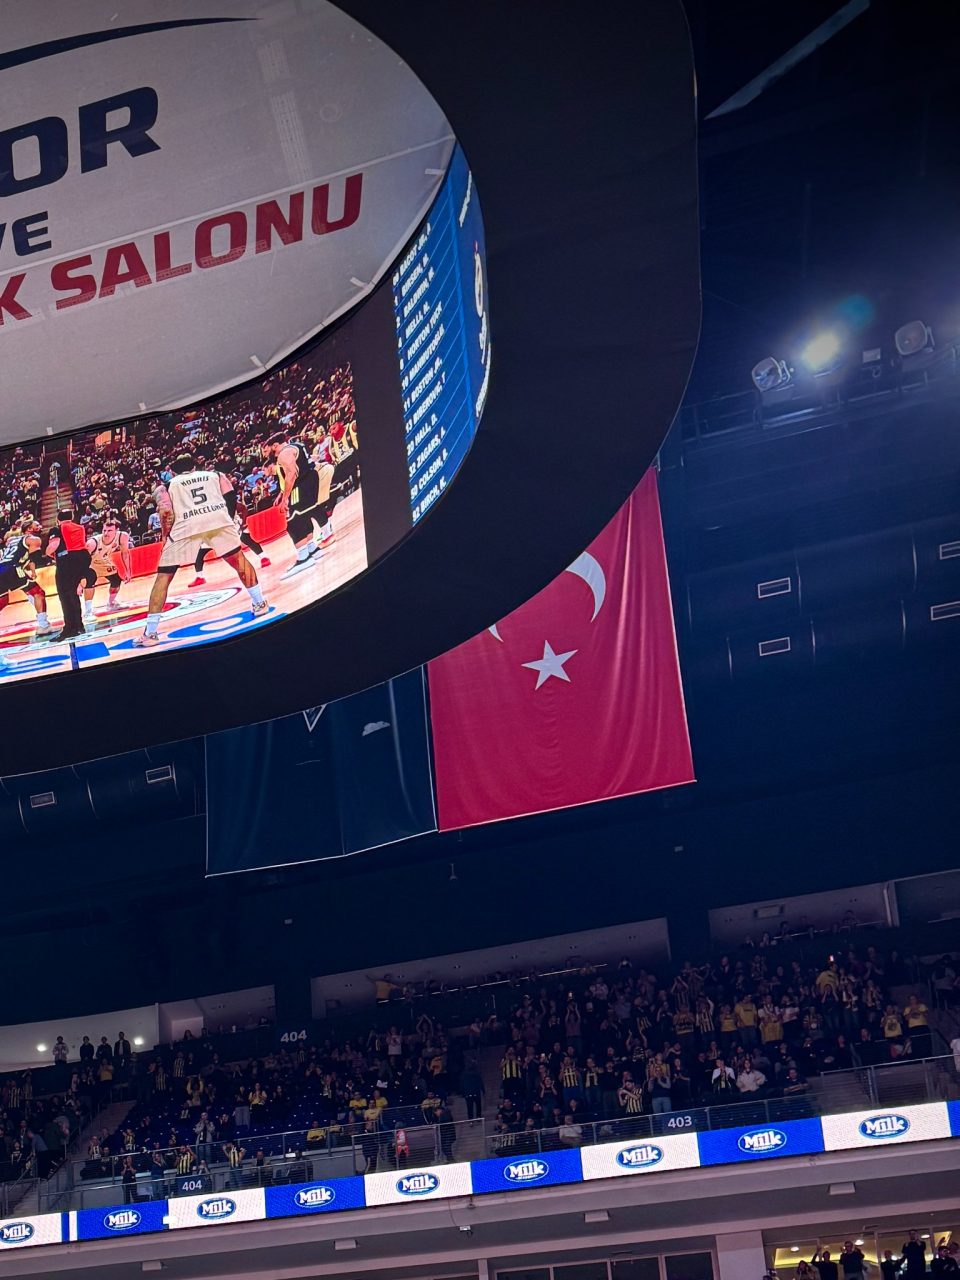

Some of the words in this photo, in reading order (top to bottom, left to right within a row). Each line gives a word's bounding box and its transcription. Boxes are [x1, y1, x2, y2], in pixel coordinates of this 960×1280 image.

[51, 173, 364, 311] SALONU
[407, 323, 430, 361] HORTON
[411, 368, 434, 402] BOSTON
[415, 421, 432, 445] HALL,
[419, 454, 443, 490] COLSON,
[191, 487, 207, 505] 5
[420, 484, 441, 513] BIRCH,
[282, 1031, 307, 1042] 404
[668, 1116, 692, 1128] 403
[866, 1118, 904, 1134] Milk
[744, 1132, 781, 1148] Milk
[622, 1147, 658, 1164] Milk
[509, 1163, 544, 1178] Milk
[182, 1180, 202, 1191] 404
[401, 1177, 434, 1191] Milk
[299, 1190, 330, 1203] Milk
[202, 1202, 231, 1215] Milk
[109, 1212, 137, 1225] Milk
[3, 1225, 29, 1240] Milk
